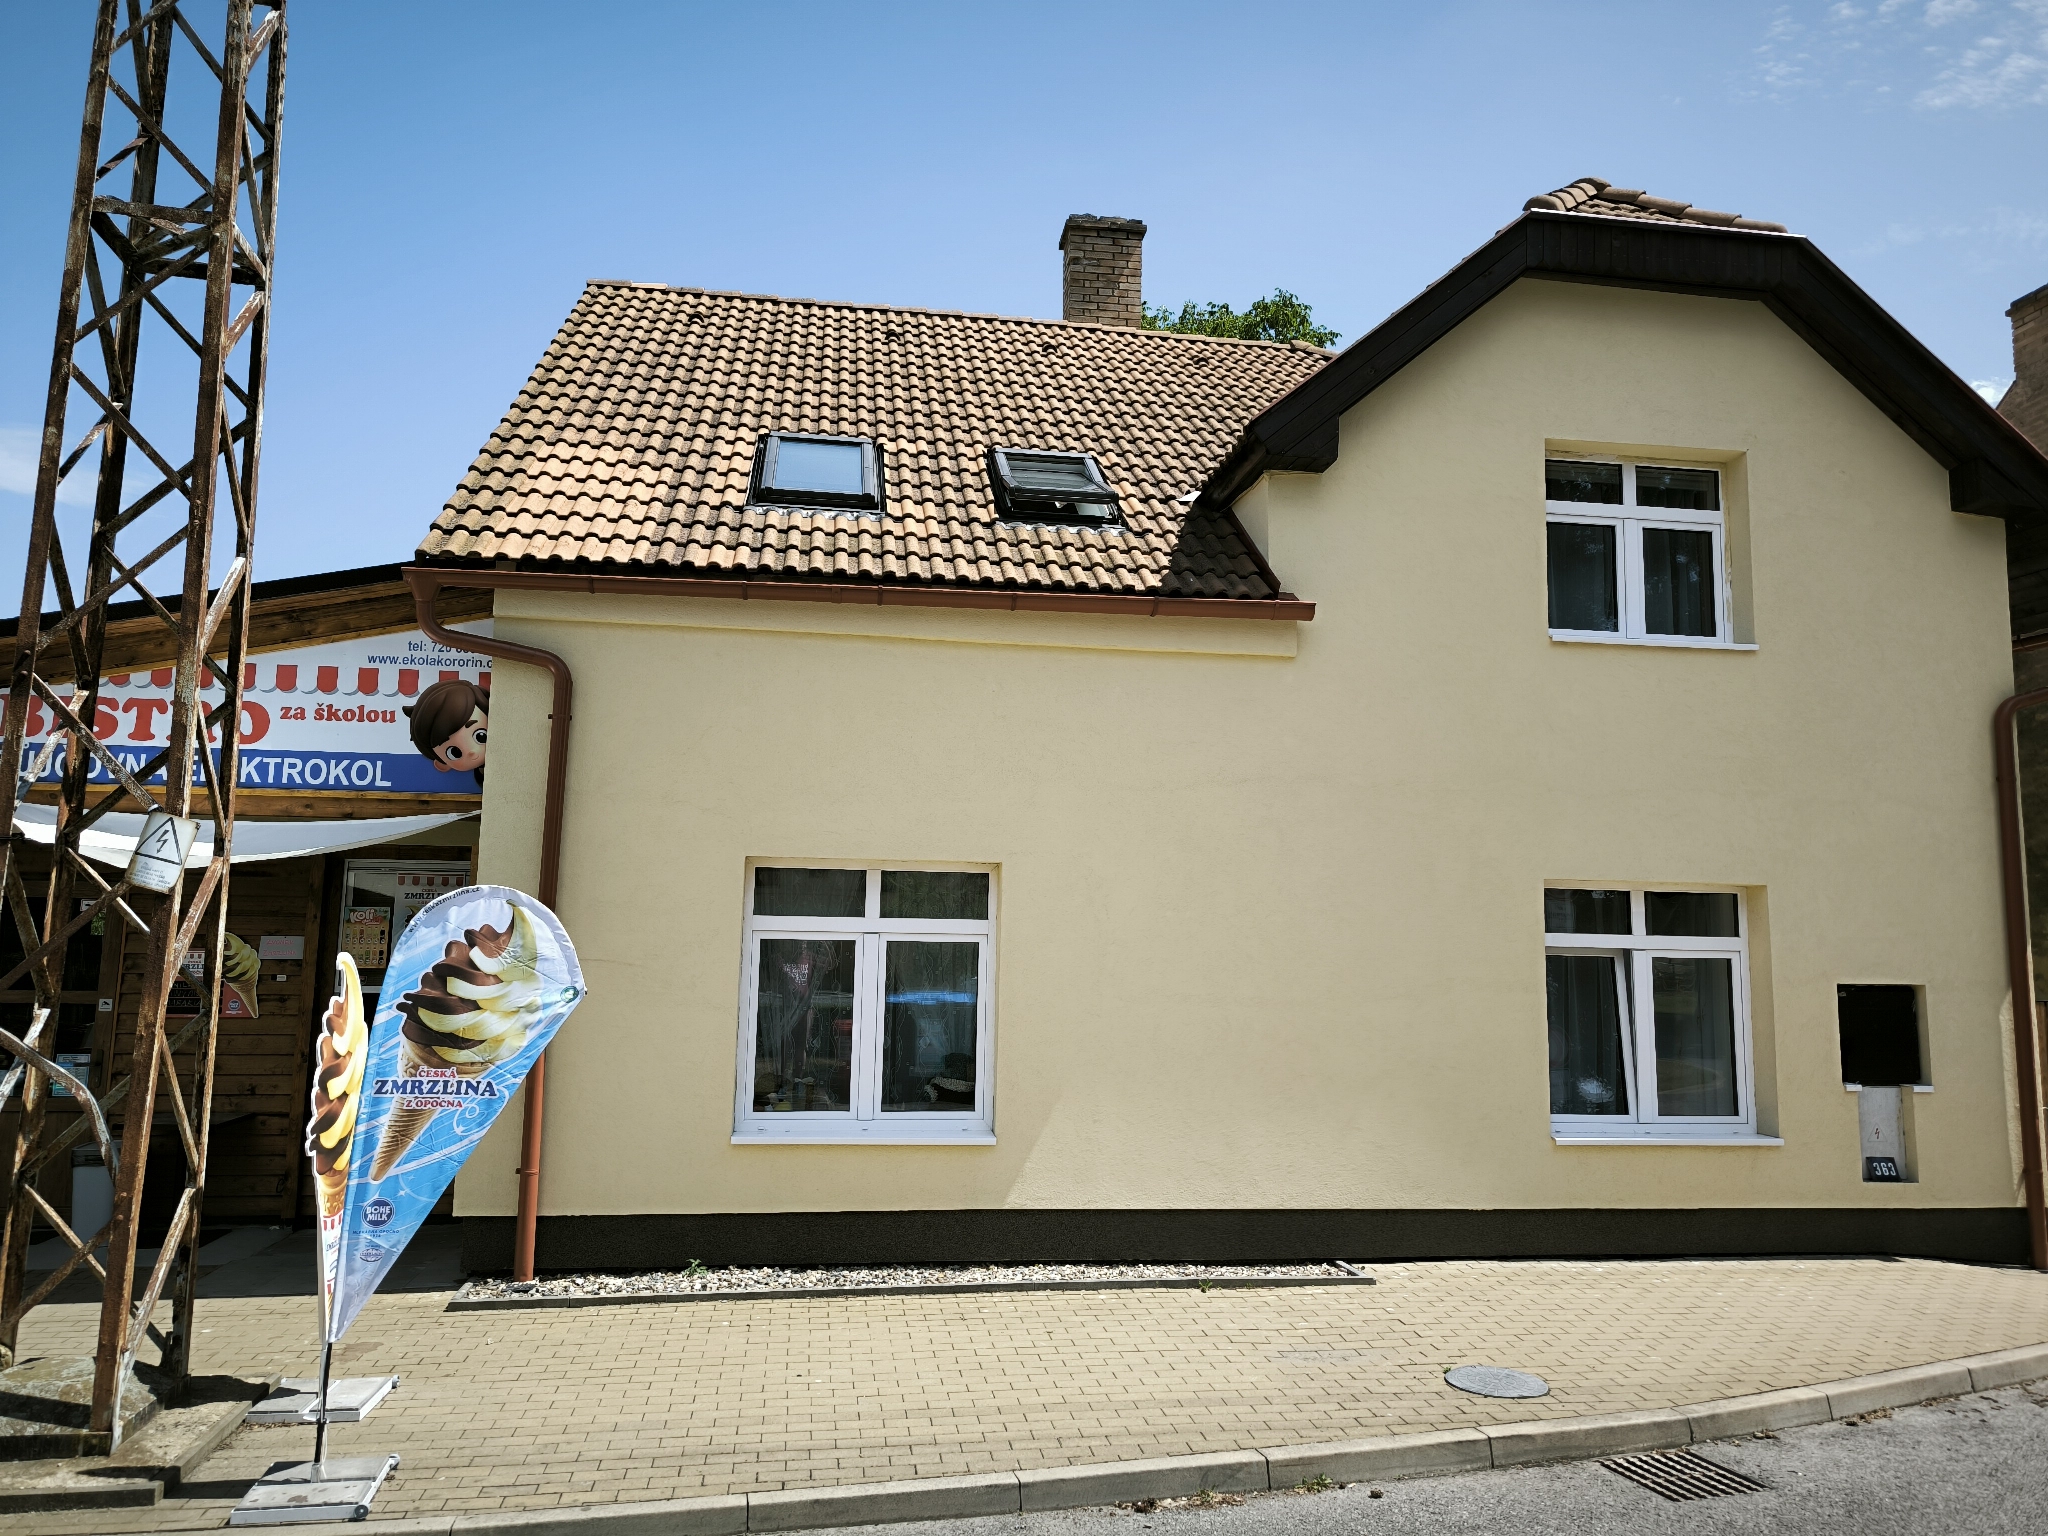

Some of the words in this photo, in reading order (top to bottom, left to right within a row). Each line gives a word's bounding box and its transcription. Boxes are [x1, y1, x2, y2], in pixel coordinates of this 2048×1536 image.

[407, 641, 427, 652] tel:
[280, 706, 306, 721] za
[313, 702, 397, 723] školou
[184, 754, 392, 787] KTROKOL
[418, 1066, 457, 1078] ČESKÁ
[374, 1079, 498, 1097] ZMRZLINA
[405, 1100, 413, 1108] Z
[415, 1097, 463, 1108] OPOČNA
[1872, 1162, 1897, 1176] 363
[366, 1205, 391, 1214] BOHE
[366, 1213, 388, 1221] MILK
